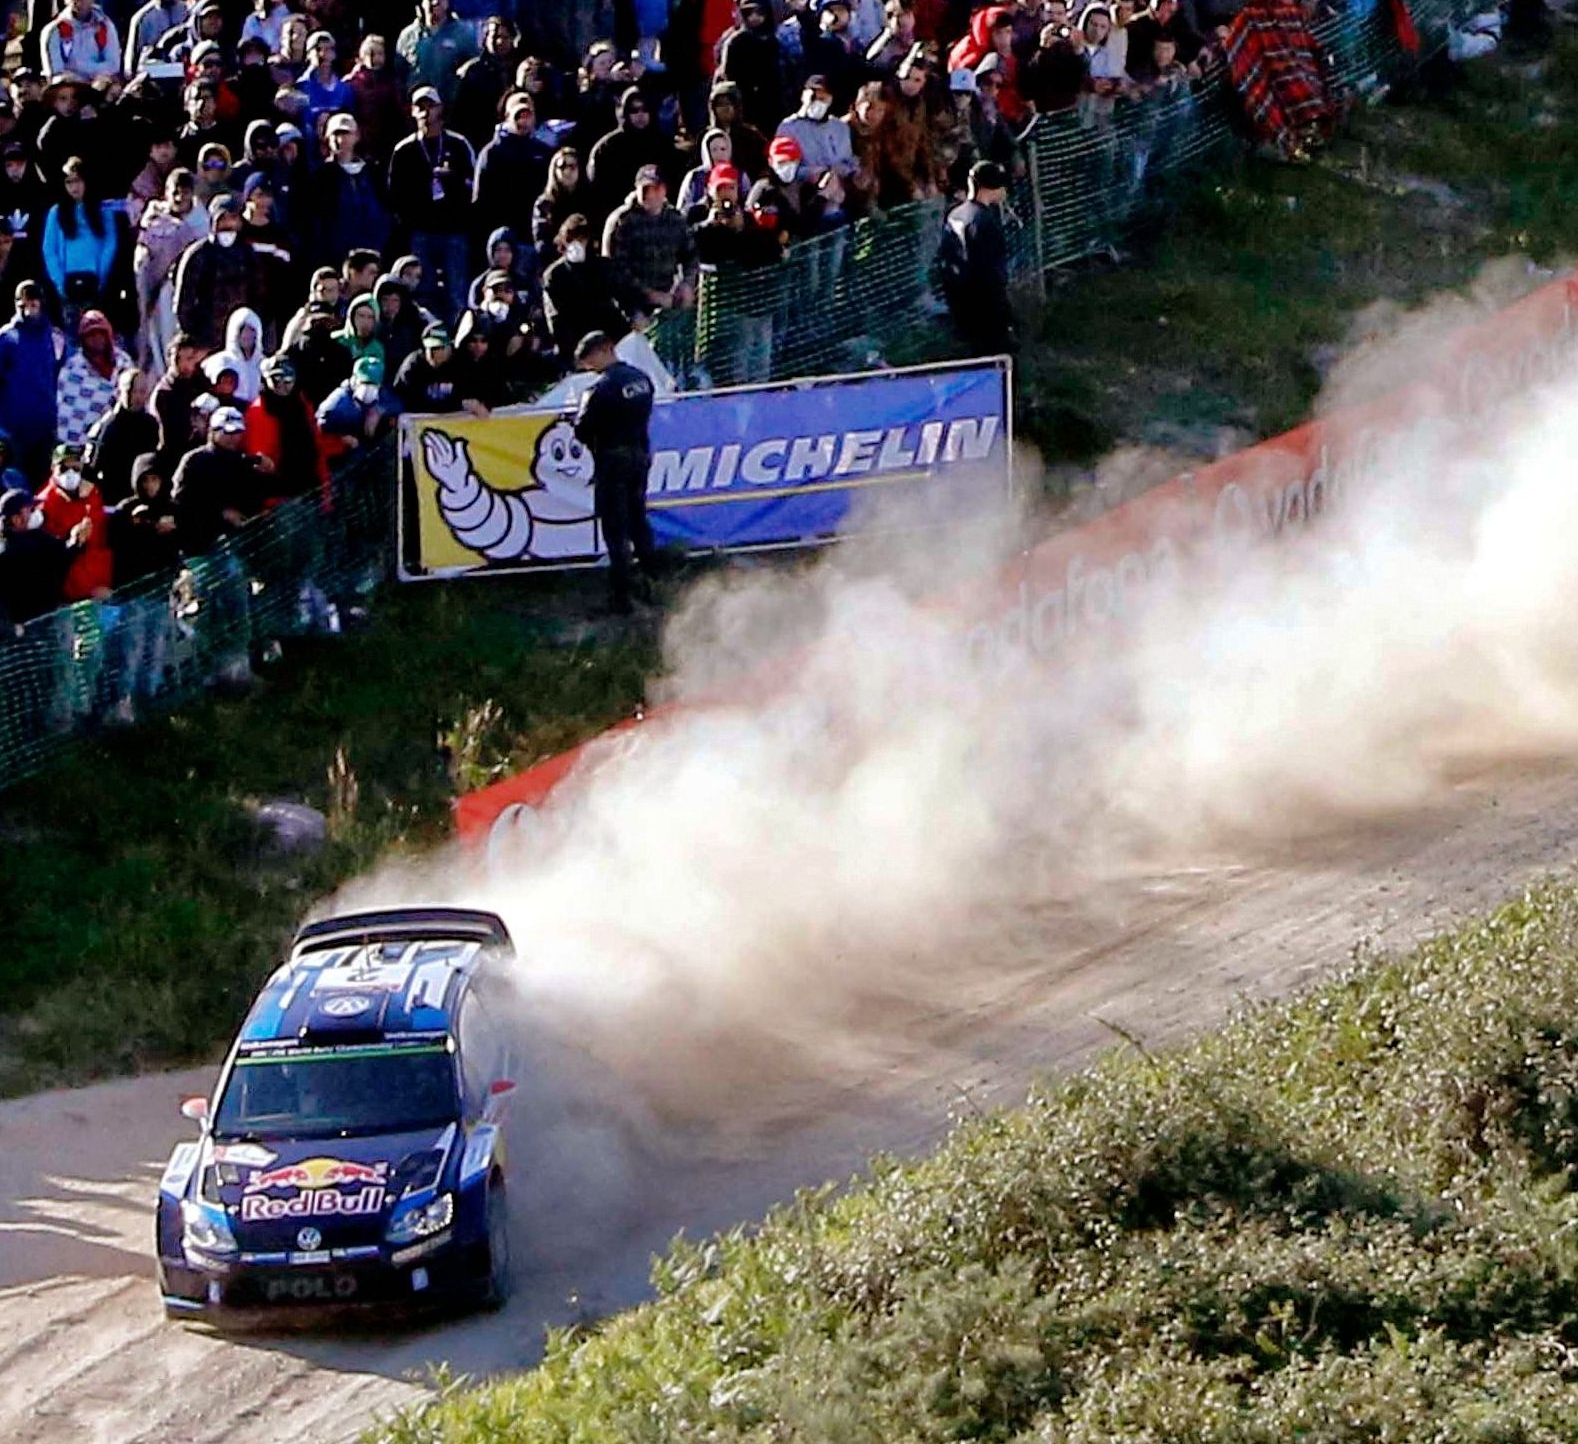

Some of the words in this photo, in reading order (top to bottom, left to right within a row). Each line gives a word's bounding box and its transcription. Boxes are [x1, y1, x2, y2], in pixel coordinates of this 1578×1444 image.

[646, 414, 999, 495] MICHELIN
[242, 1189, 313, 1222] Red
[313, 1186, 385, 1216] Bull
[266, 1273, 357, 1301] POLO
